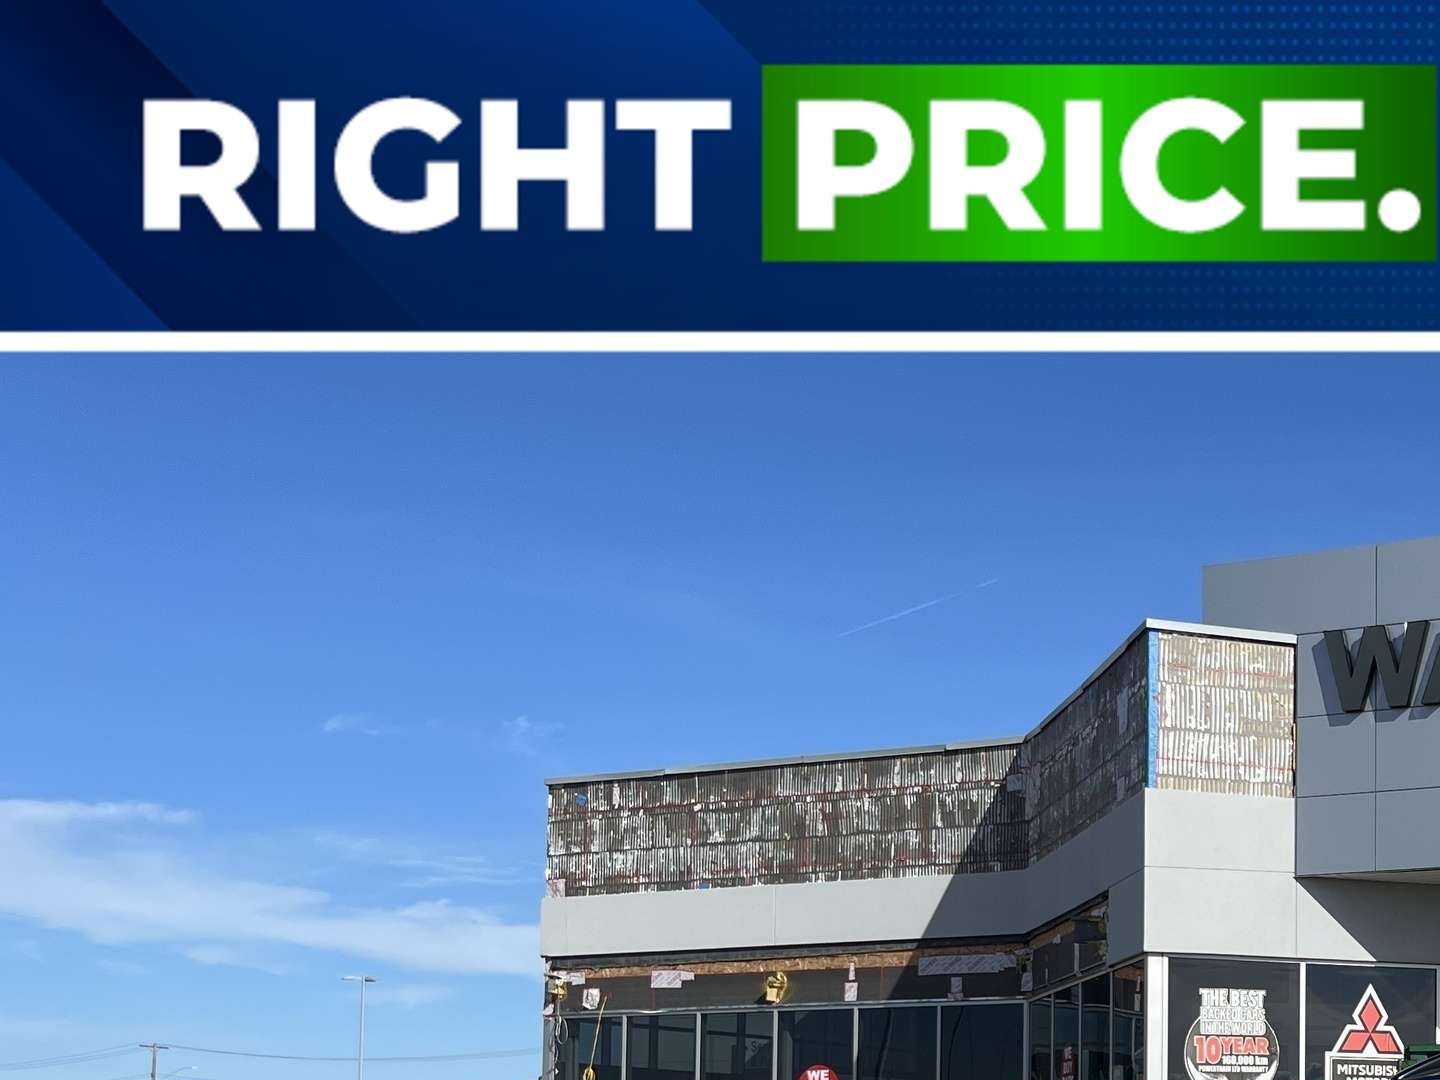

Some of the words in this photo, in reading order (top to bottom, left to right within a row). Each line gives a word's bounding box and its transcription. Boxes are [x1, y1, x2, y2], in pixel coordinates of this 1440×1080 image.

[1199, 988, 1229, 1007] THE
[1230, 988, 1267, 1008] BEST
[1201, 1007, 1239, 1020] BACKED
[1240, 1008, 1266, 1021] CARS
[1232, 1021, 1266, 1035] WORLD
[1194, 1036, 1222, 1064] 10
[1221, 1036, 1269, 1055] YEAR
[1255, 1056, 1268, 1065] km
[807, 1069, 830, 1080] WE
[1337, 1064, 1397, 1076] MITSUBISH
